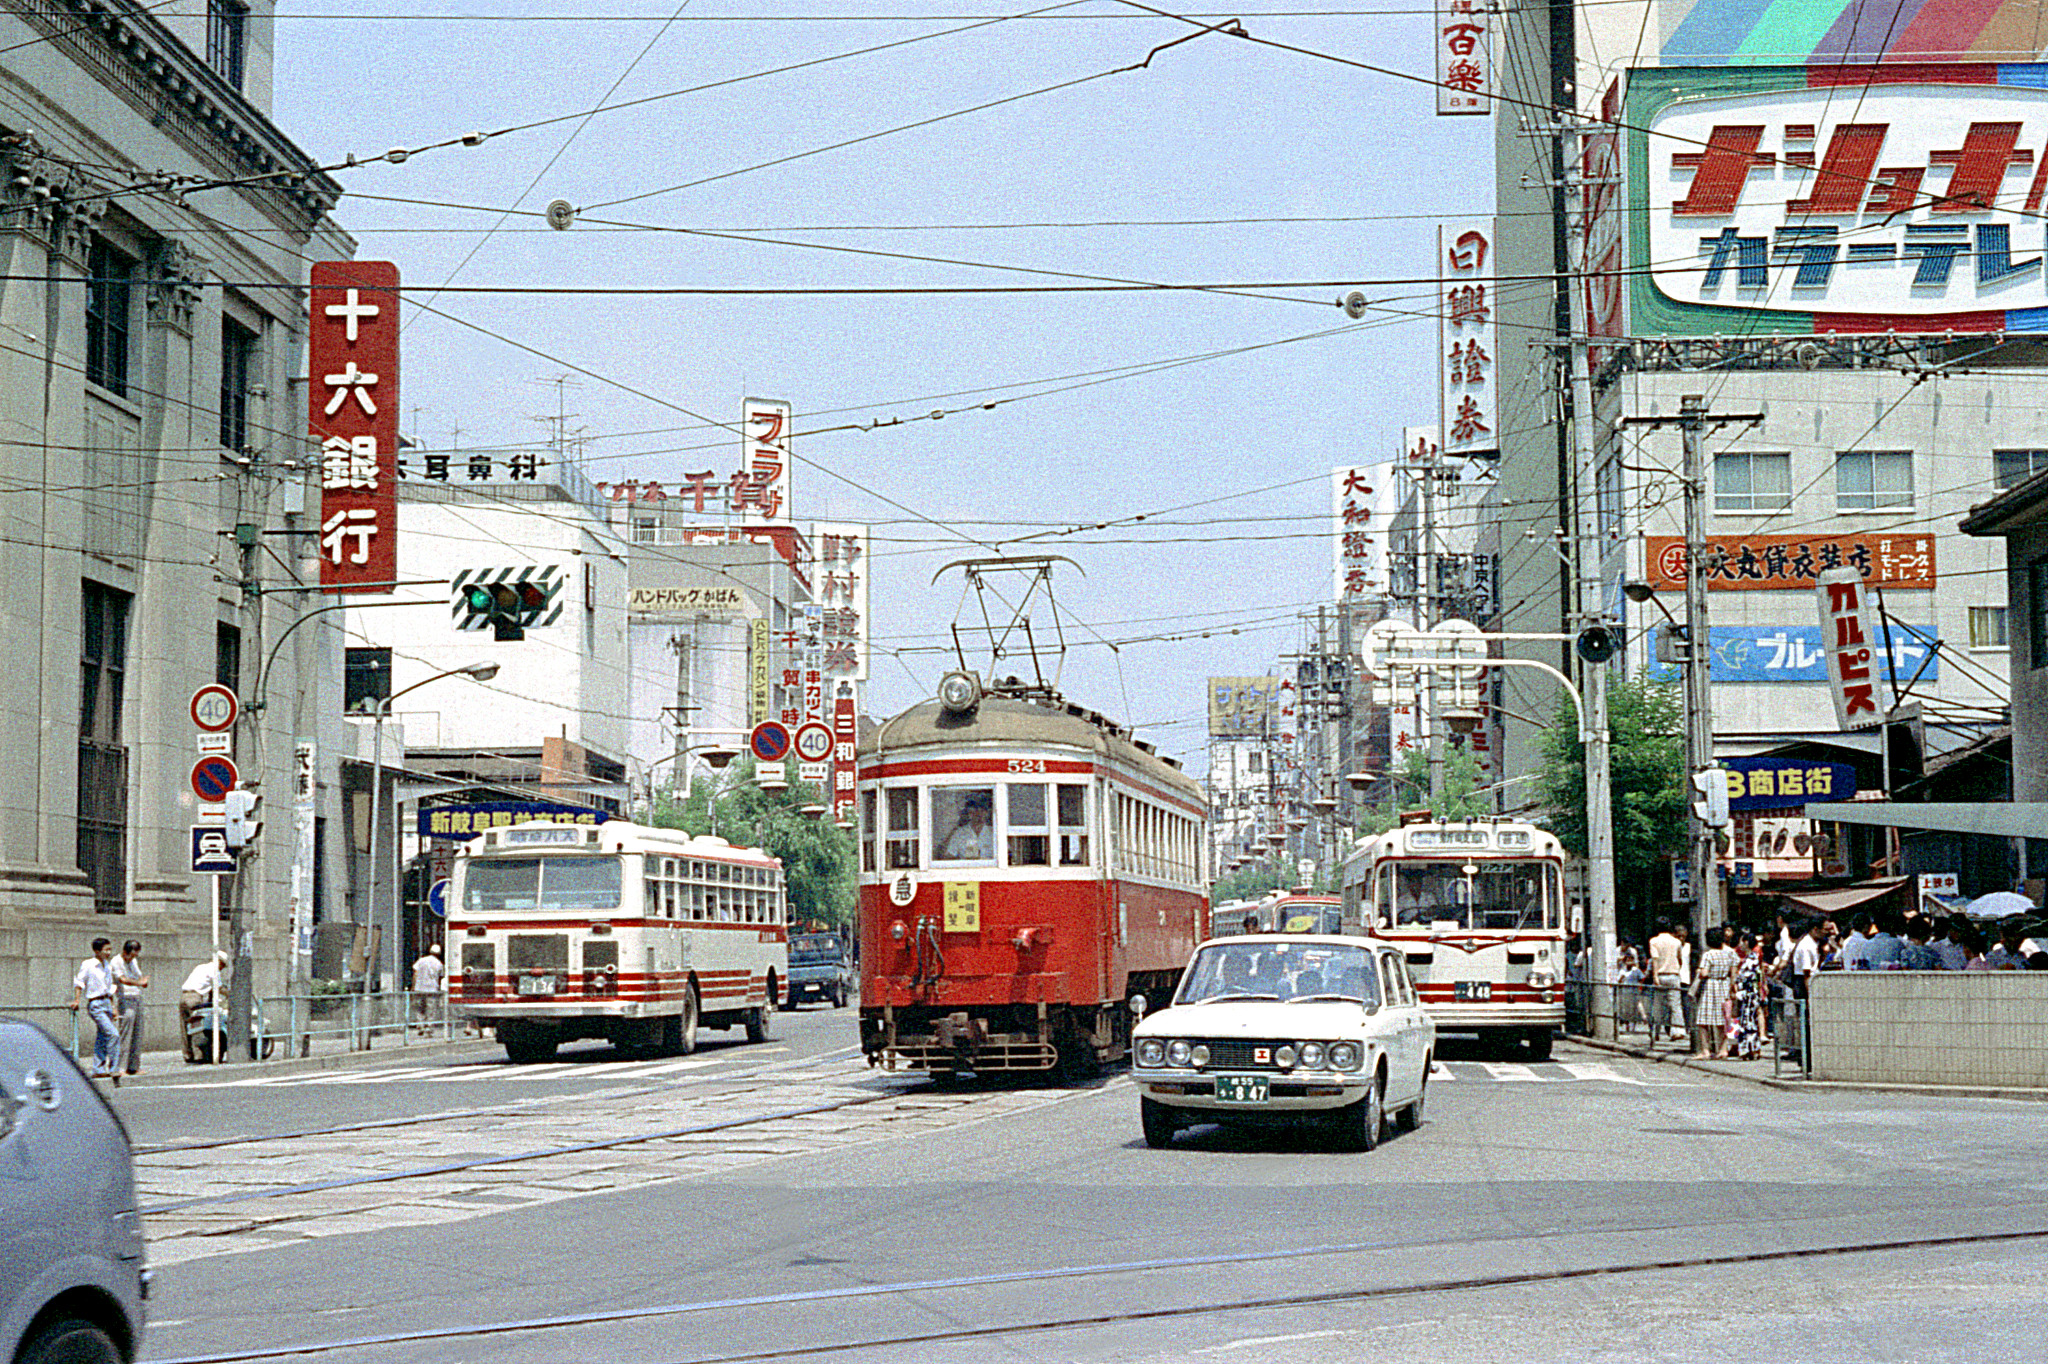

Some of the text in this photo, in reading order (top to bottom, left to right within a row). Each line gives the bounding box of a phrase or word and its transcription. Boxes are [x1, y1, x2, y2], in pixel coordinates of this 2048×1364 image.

[1671, 121, 2048, 215] ナショナ
[1699, 223, 2043, 288] カラーテレ
[322, 288, 380, 564] 十六銀行
[704, 589, 740, 603] かばん
[1827, 582, 1877, 716] カルピス
[200, 698, 228, 719] 40
[802, 734, 827, 751] 40
[1007, 760, 1047, 773] 524
